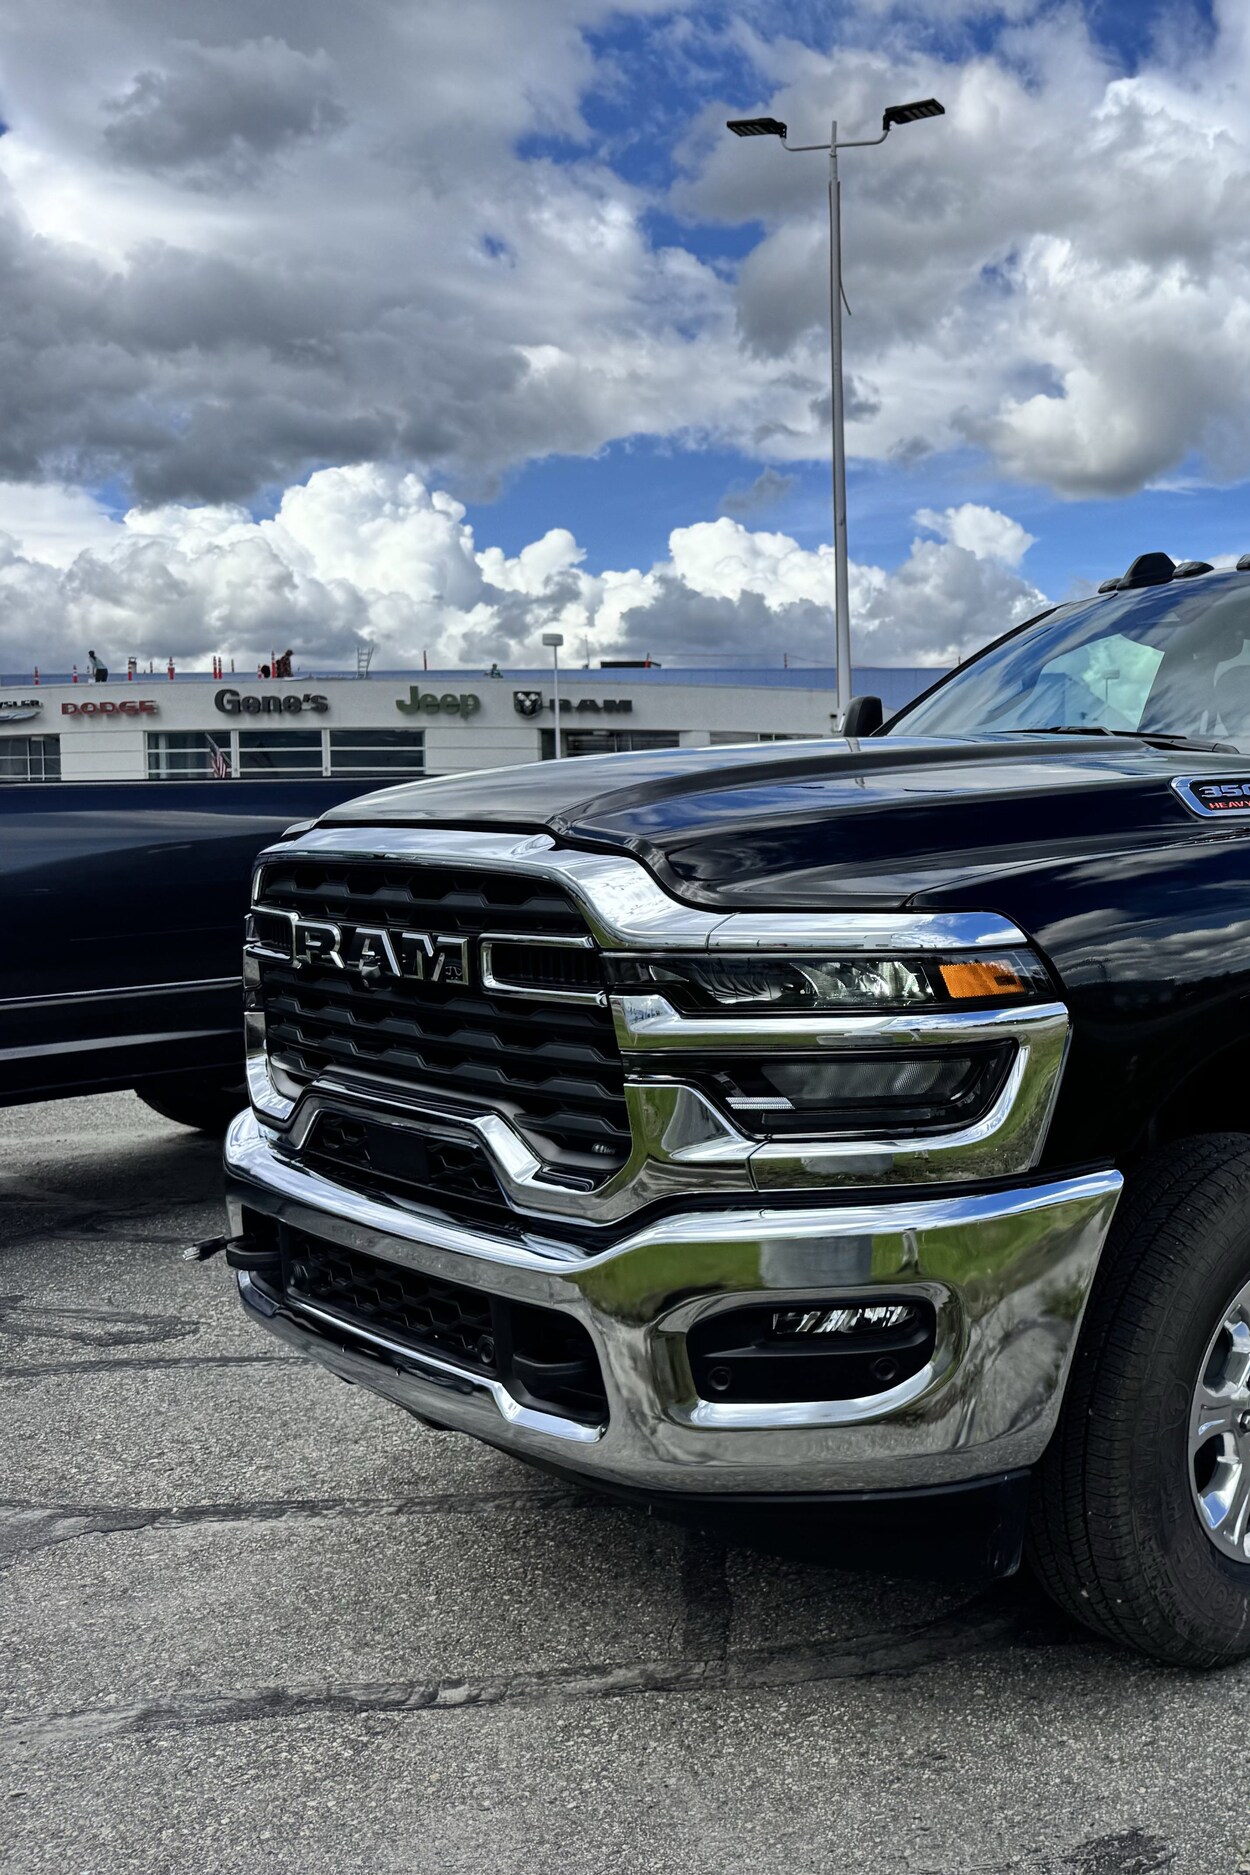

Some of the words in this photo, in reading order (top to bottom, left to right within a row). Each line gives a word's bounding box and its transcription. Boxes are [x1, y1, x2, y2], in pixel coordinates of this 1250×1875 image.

[61, 700, 159, 715] DODGE
[214, 689, 328, 714] Gene's
[396, 686, 481, 718] Jeep
[549, 699, 633, 713] RAM
[295, 919, 470, 986] RAM
